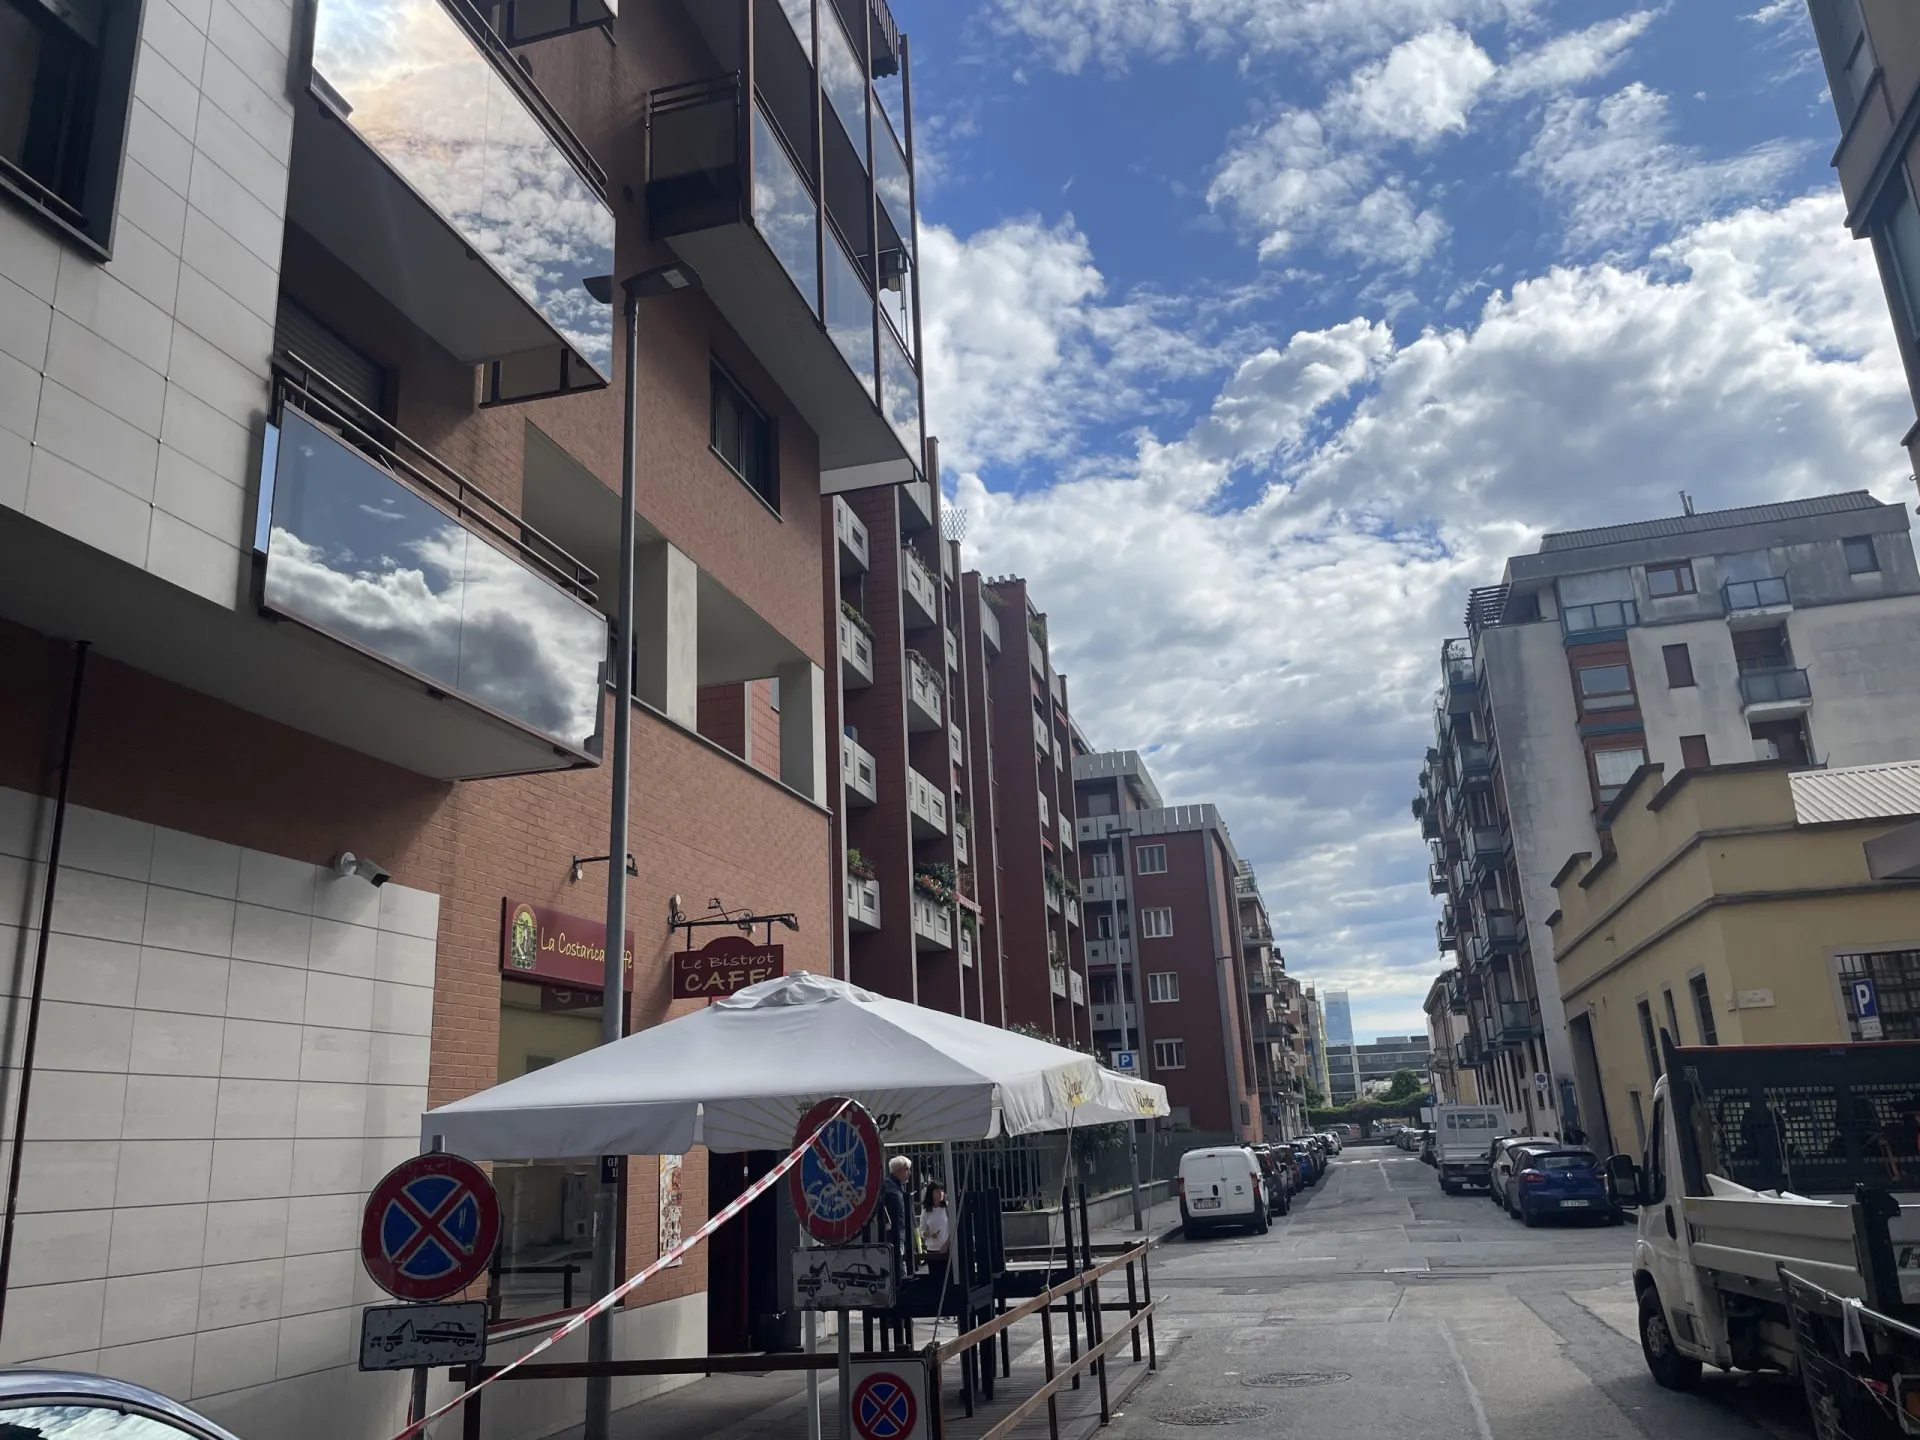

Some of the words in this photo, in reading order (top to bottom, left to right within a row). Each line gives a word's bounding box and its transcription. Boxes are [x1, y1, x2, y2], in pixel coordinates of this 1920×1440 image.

[541, 927, 555, 951] La
[558, 932, 605, 962] Costarica
[681, 959, 702, 970] Le
[708, 952, 775, 968] Bistrot
[1856, 984, 1870, 1015] P
[1121, 1054, 1130, 1067] P
